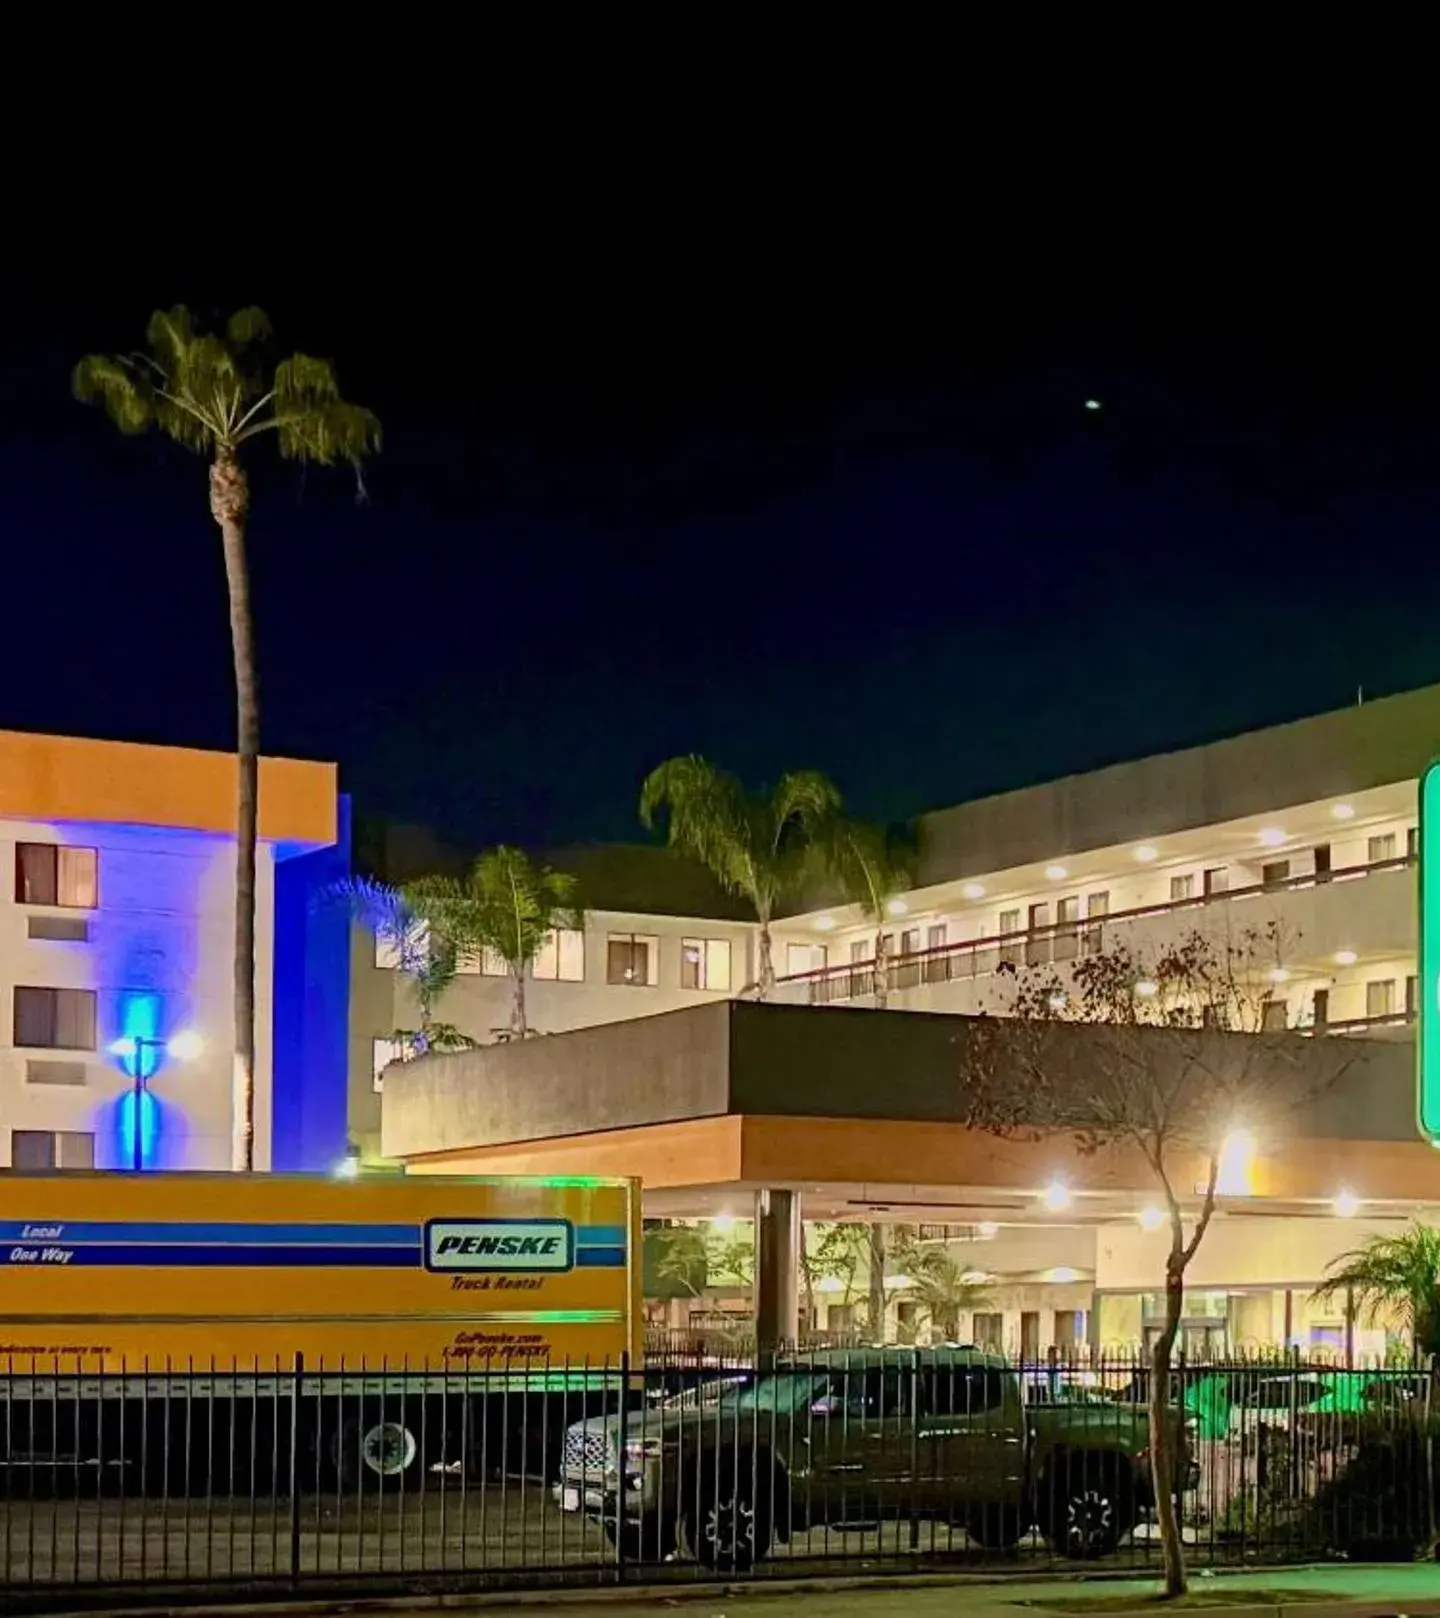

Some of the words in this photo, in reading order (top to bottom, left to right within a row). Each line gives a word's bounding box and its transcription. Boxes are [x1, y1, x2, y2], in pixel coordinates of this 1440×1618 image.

[22, 1224, 64, 1238] Local
[437, 1236, 562, 1255] PENSKE
[10, 1247, 39, 1261] One
[42, 1247, 74, 1264] Way
[451, 1276, 491, 1290] Truck
[493, 1276, 544, 1290] Rental
